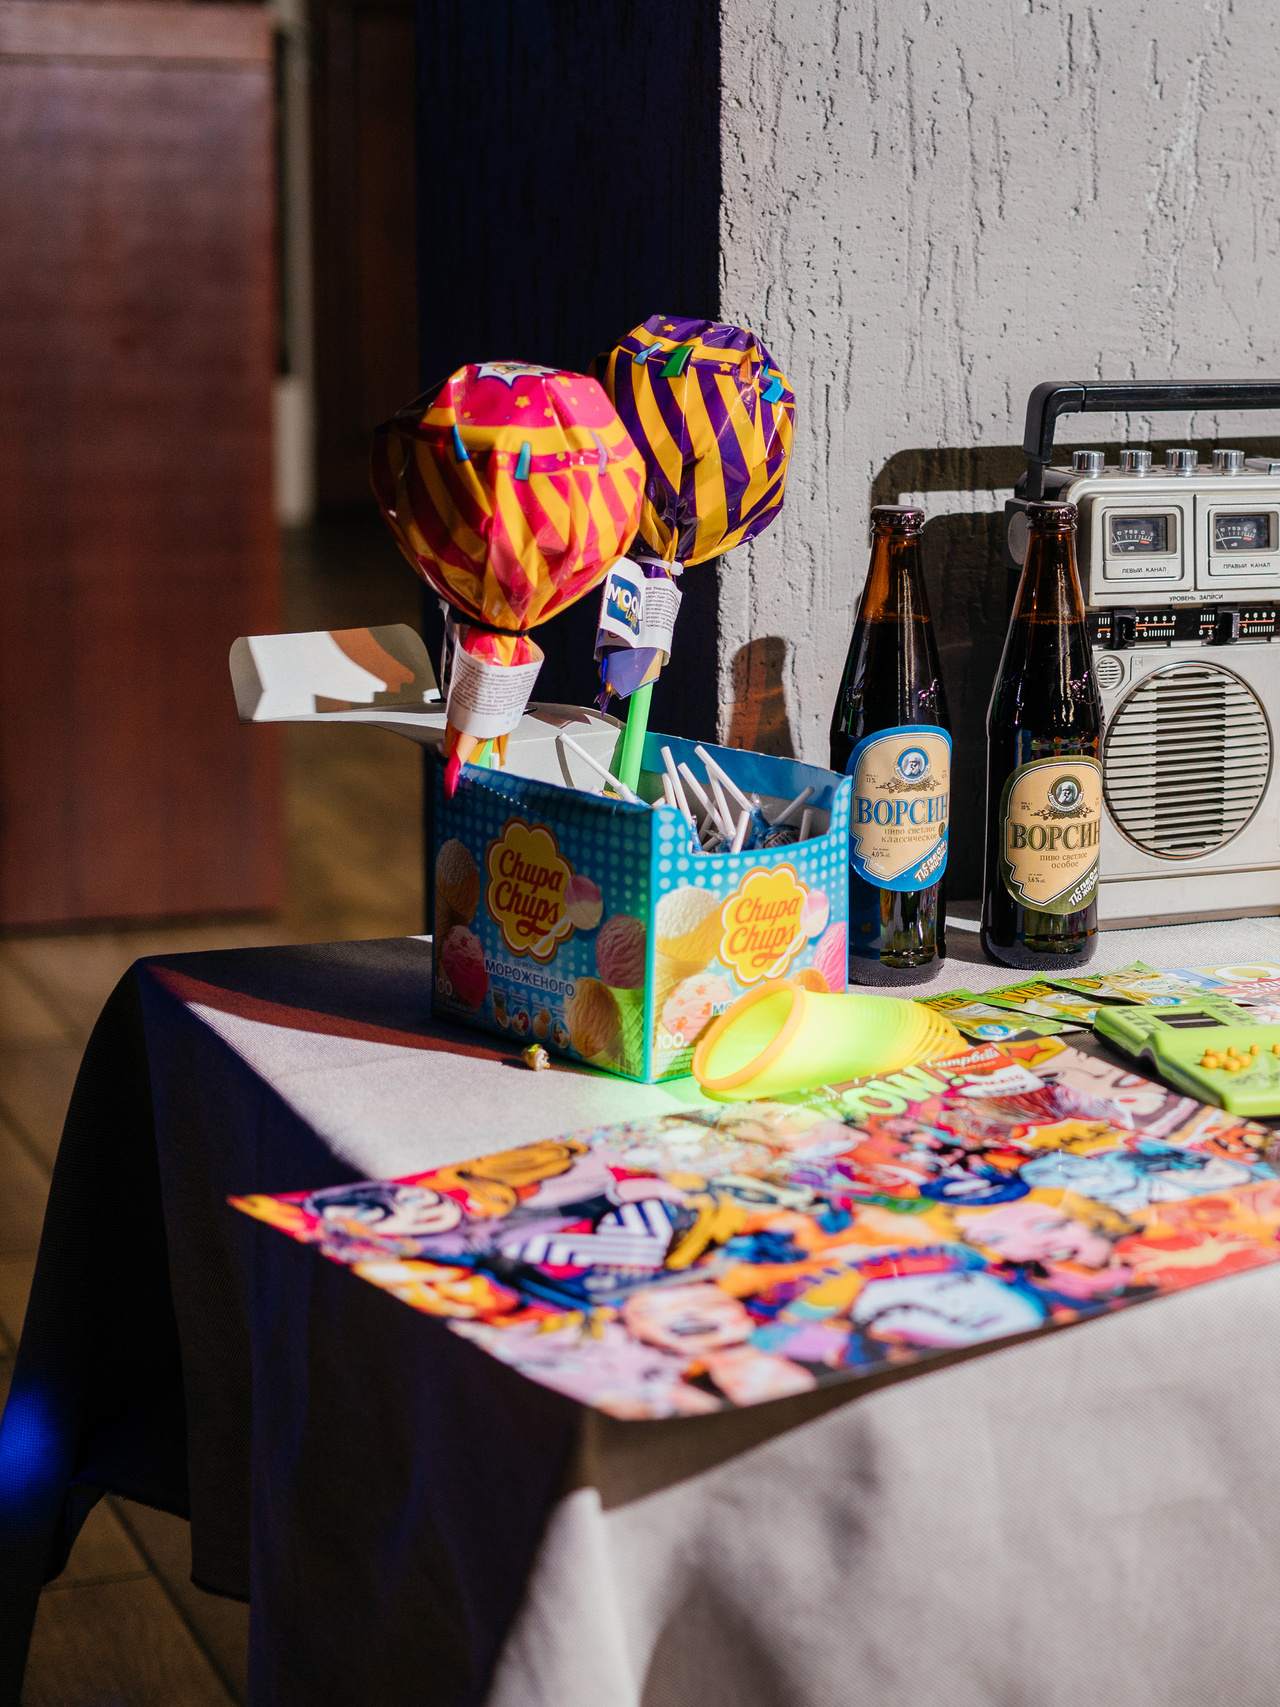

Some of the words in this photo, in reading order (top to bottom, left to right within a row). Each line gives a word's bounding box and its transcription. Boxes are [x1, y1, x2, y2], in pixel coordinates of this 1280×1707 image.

[881, 833, 938, 843] классическое
[908, 826, 936, 835] светлое
[1040, 854, 1060, 862] пиво
[1062, 852, 1088, 861] светлое
[1051, 861, 1079, 869] особое
[499, 849, 564, 894] Chupa
[495, 881, 561, 936] Chups
[735, 896, 801, 925] Chupa
[728, 923, 796, 967] Chups
[514, 958, 522, 966] СО
[523, 961, 544, 972] ВКУСОМ
[434, 976, 453, 996] 100
[484, 959, 576, 998] МОРОЖЕНОГО
[657, 1033, 684, 1049] 100
